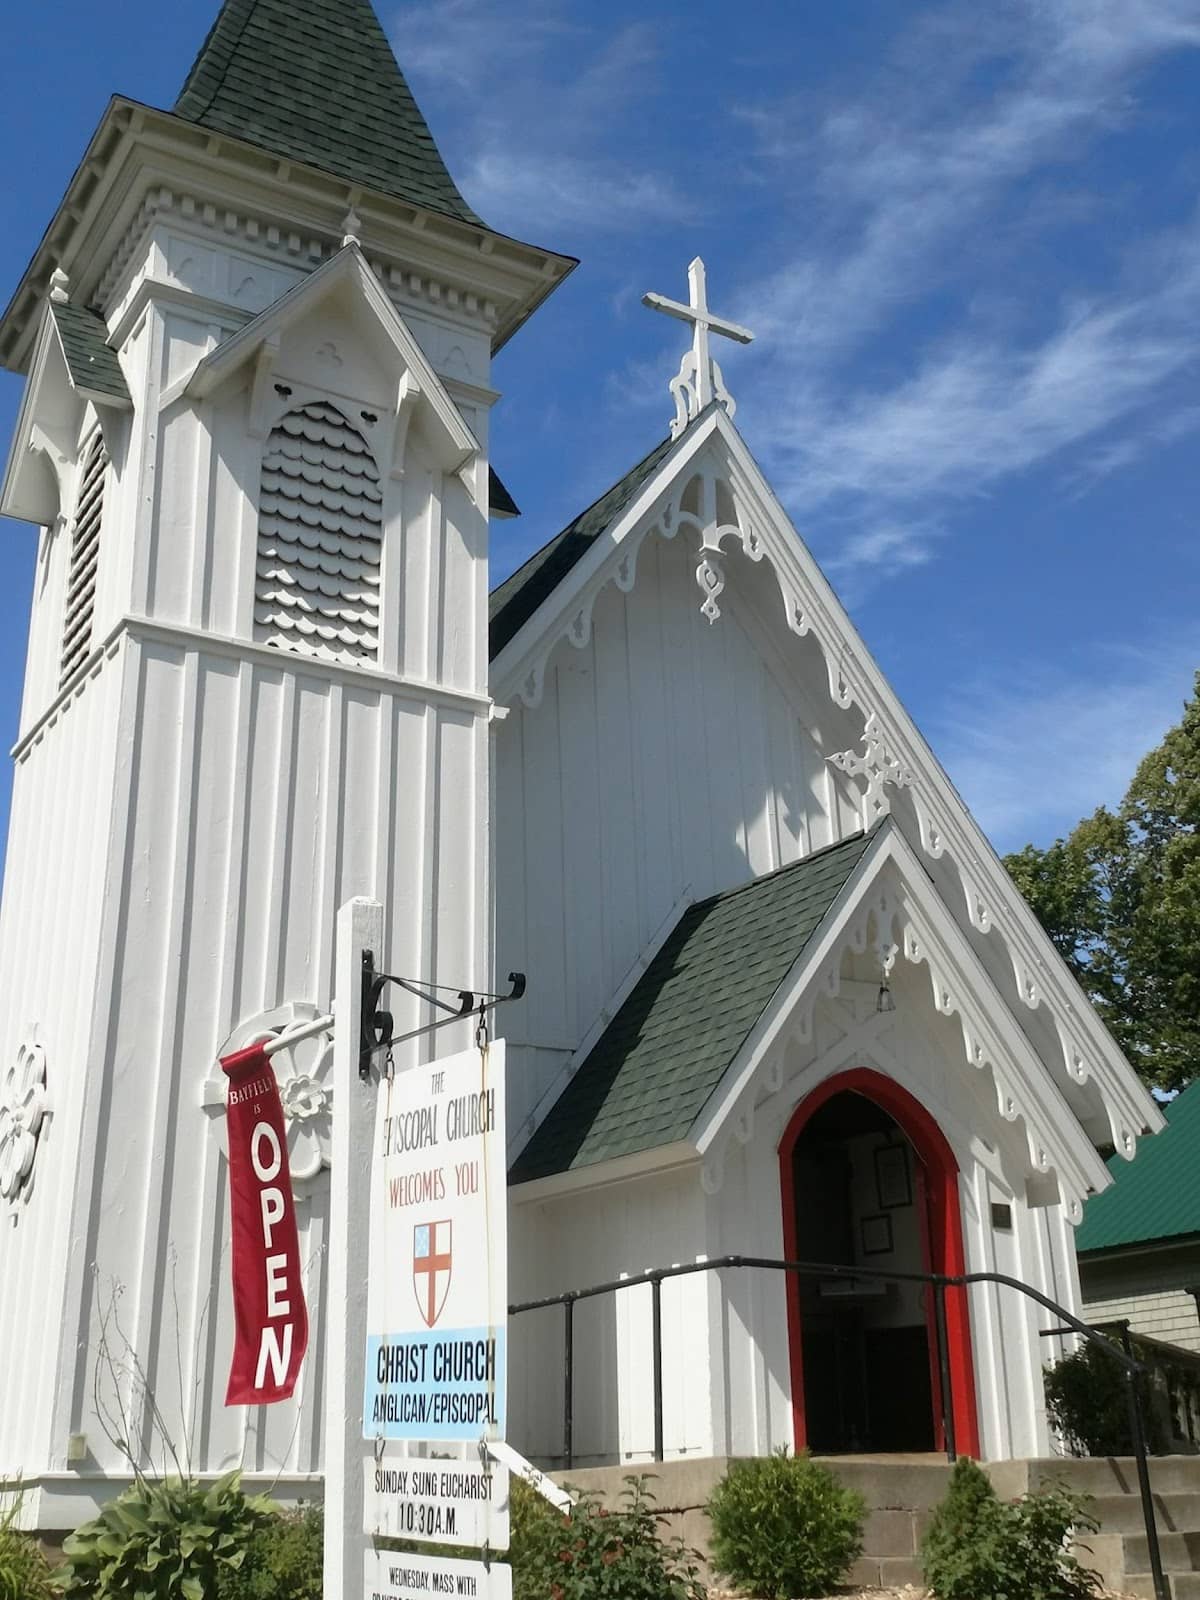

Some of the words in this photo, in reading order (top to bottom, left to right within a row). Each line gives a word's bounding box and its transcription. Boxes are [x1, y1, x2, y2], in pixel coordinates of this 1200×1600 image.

[432, 1072, 445, 1095] THE
[253, 1103, 261, 1115] IS
[383, 1104, 438, 1158] PISCOPAL
[447, 1088, 495, 1141] CHURCH
[390, 1168, 445, 1208] WELCOMES
[455, 1161, 479, 1196] YOU
[251, 1121, 294, 1389] OPEN
[377, 1343, 428, 1384] CHRIST
[433, 1338, 496, 1382] CHURCH
[372, 1391, 498, 1425] ANGLICAN/EPISCOPAL
[375, 1469, 408, 1498] SUNDAY,
[412, 1471, 437, 1496] SUNG
[440, 1473, 493, 1500] EUCHARIST
[432, 1573, 454, 1594] MASS
[456, 1575, 477, 1596] WITH
